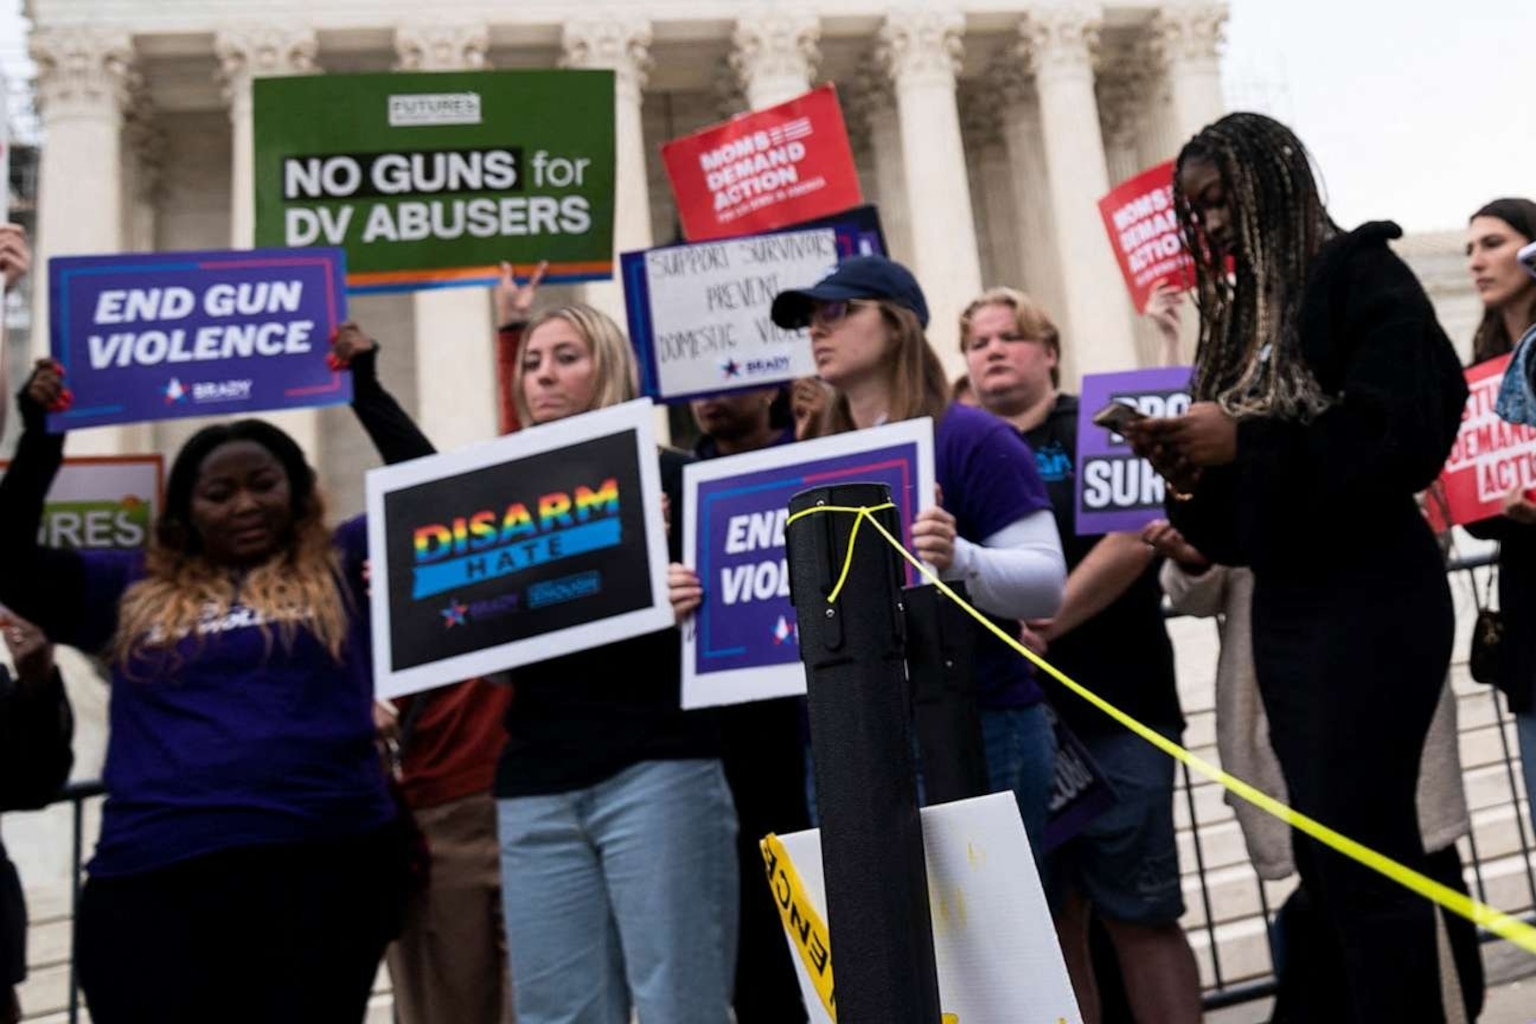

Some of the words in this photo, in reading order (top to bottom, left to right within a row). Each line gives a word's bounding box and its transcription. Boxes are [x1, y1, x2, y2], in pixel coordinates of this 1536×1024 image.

[700, 130, 770, 171] MOMS
[706, 141, 806, 192] DEMAND
[284, 158, 363, 198] NO
[371, 150, 518, 194] GUNS
[532, 150, 592, 188] for
[714, 164, 799, 211] ACTION
[284, 206, 355, 248] DV
[362, 195, 592, 243] ABUSERS
[650, 243, 731, 277] SUPPORT
[739, 232, 838, 265] SURVIVORS
[93, 286, 196, 324] END
[203, 280, 303, 317] GUN
[88, 320, 314, 370] VIOLENCE
[658, 323, 738, 363] DOMESTIC
[746, 356, 792, 375] BRADY
[192, 379, 252, 401] BRADY
[412, 477, 620, 564] DISARM
[464, 534, 564, 580] HATE
